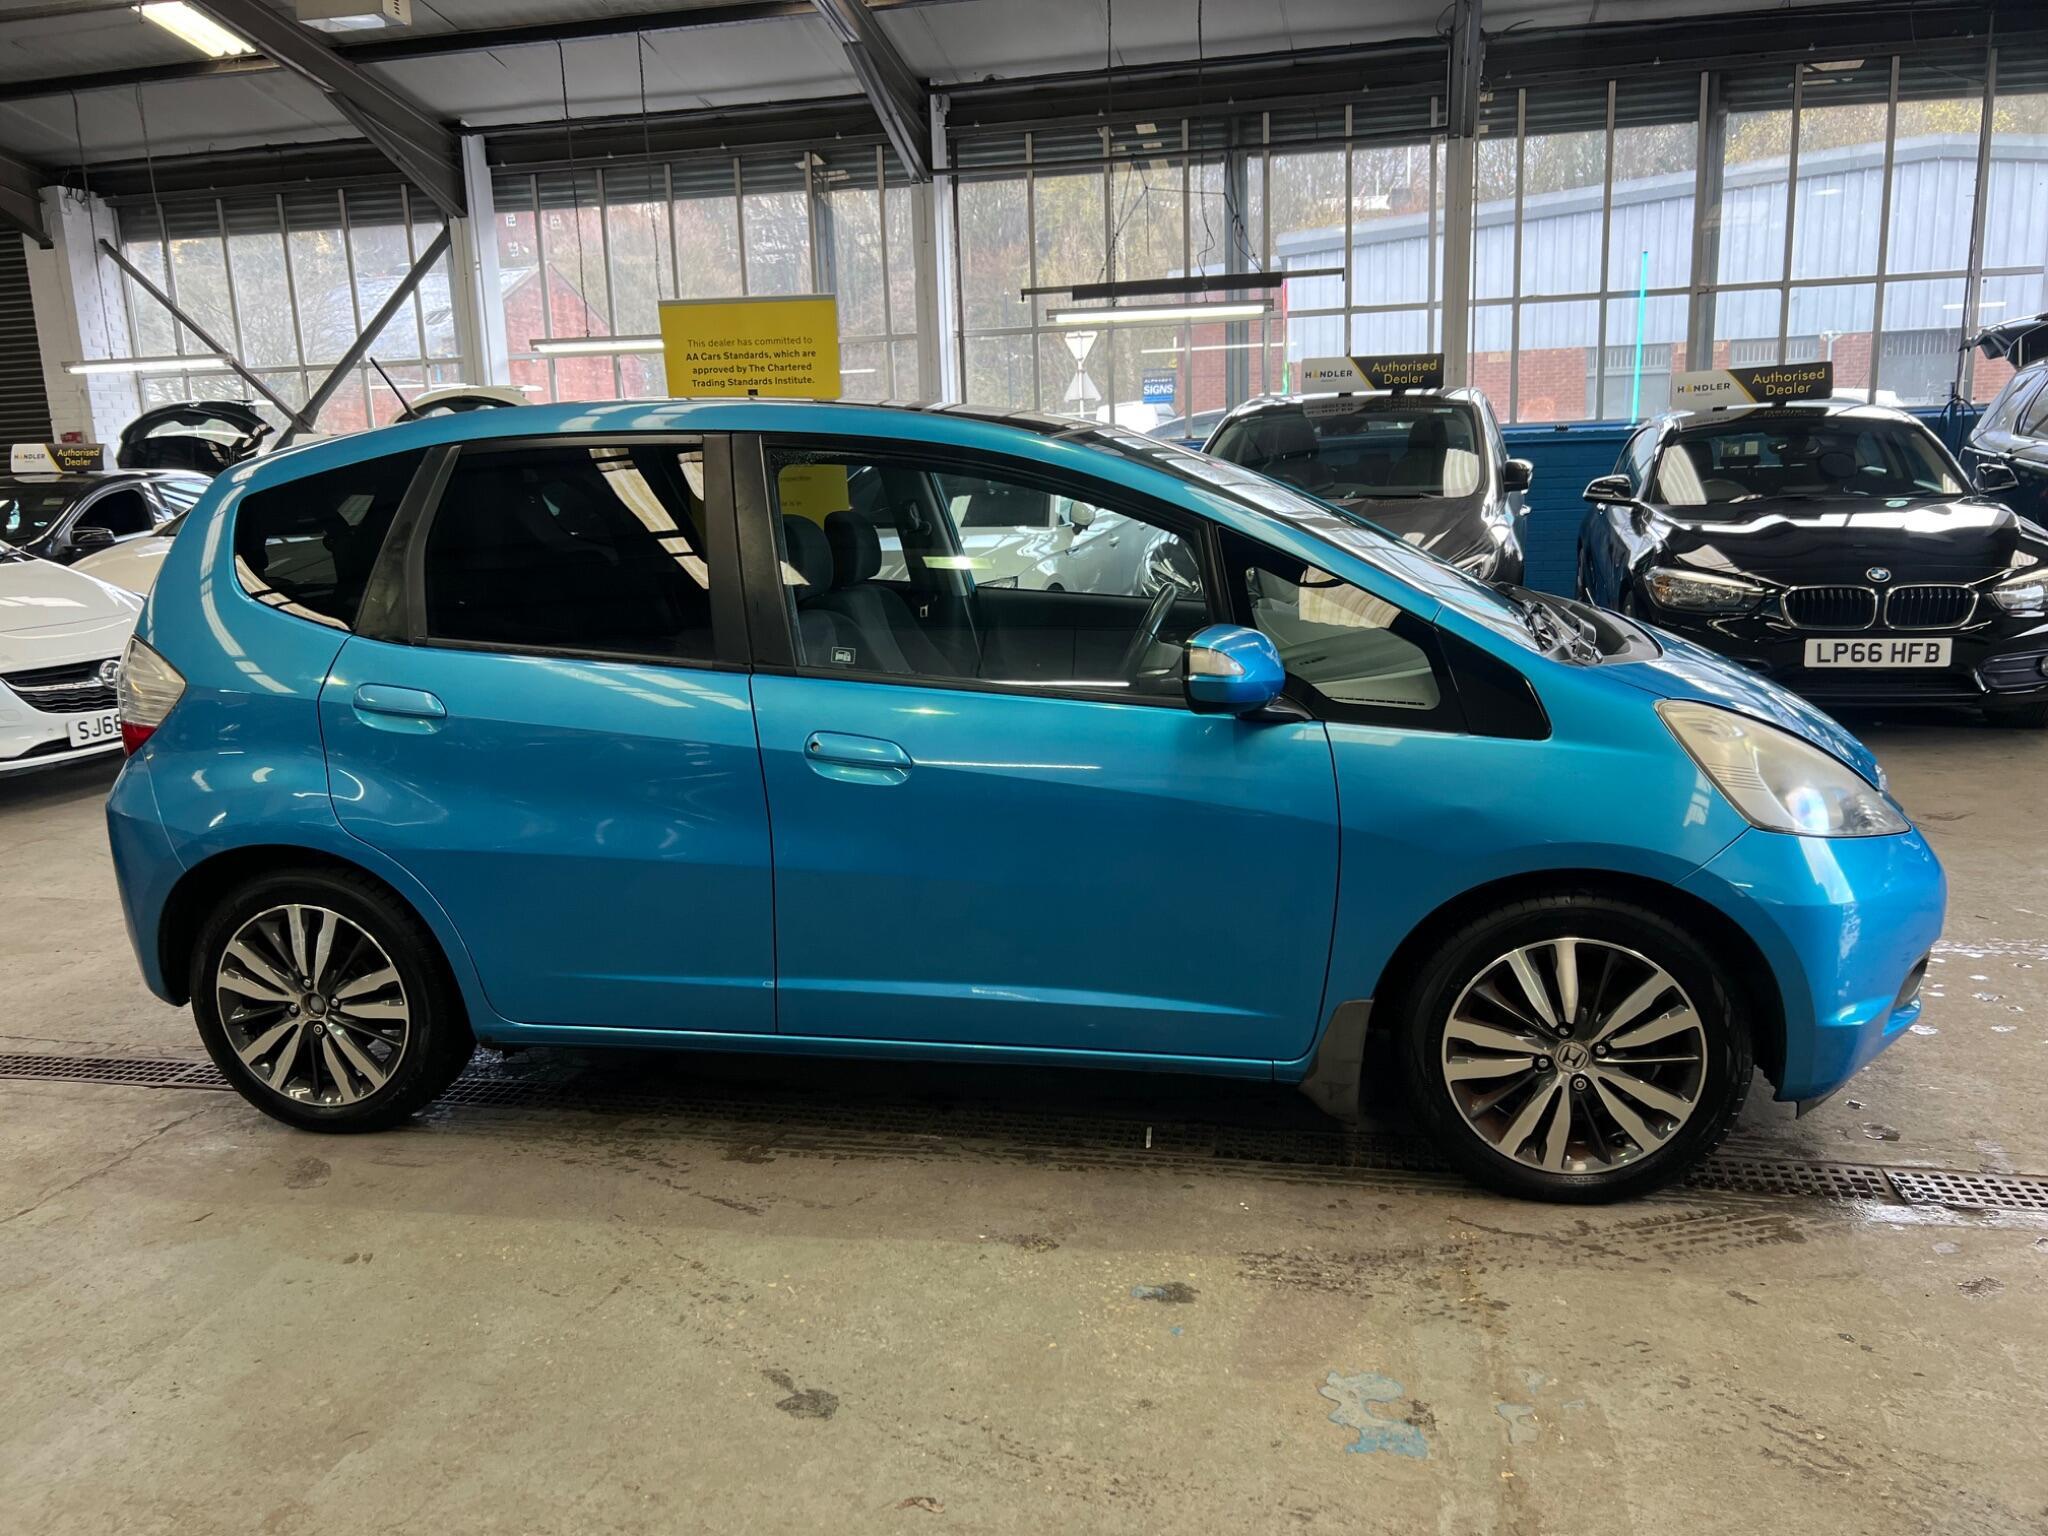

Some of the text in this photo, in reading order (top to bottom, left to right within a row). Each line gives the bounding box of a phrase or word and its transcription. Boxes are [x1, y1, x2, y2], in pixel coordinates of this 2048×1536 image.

[688, 336, 813, 348] This dealer has committed to
[686, 350, 816, 361] AA Cars Standards, which are
[692, 362, 812, 375] approved by The Chartered
[1371, 360, 1438, 373] Authorised
[692, 375, 815, 388] Trading Standards Institute.
[1383, 374, 1424, 385] Dealer
[1752, 368, 1825, 385] Authorised
[1144, 384, 1173, 395] SIGNS
[1765, 383, 1811, 396] Dealer
[57, 448, 99, 457] Authorised
[65, 458, 92, 466] Dealer
[1816, 642, 1941, 663] LP66 HFB
